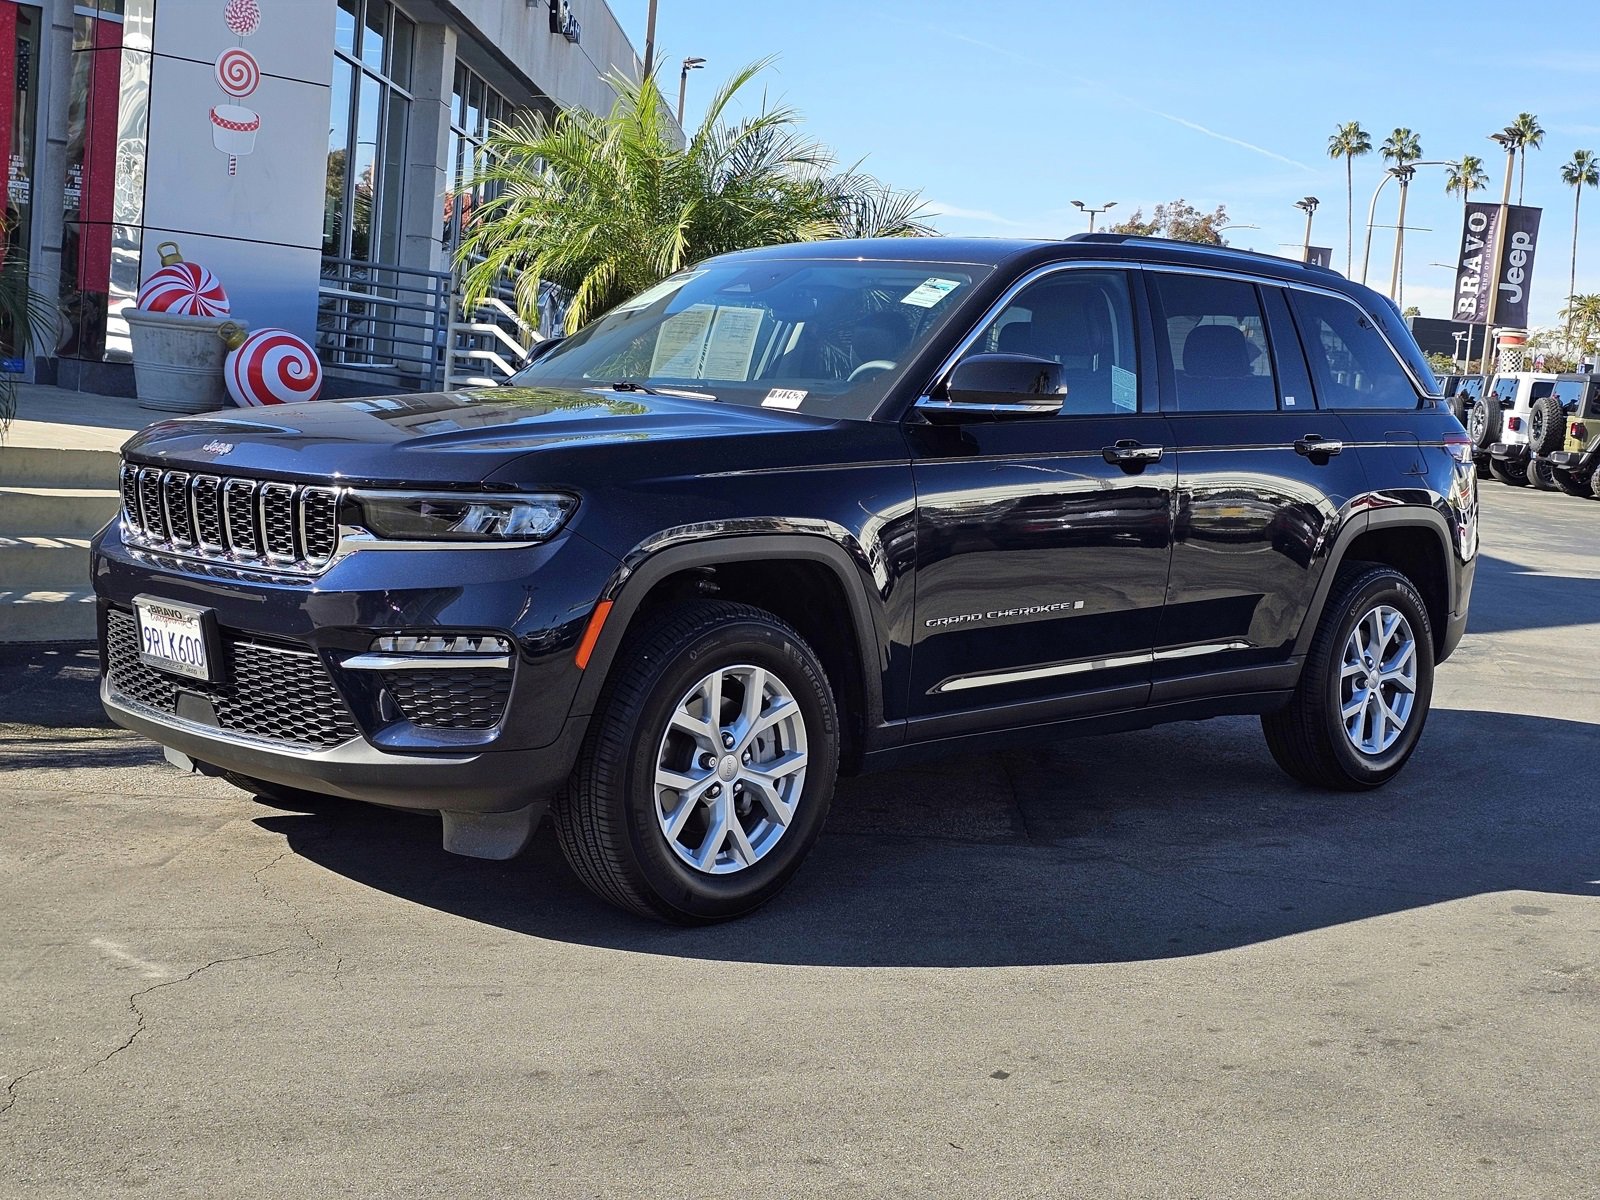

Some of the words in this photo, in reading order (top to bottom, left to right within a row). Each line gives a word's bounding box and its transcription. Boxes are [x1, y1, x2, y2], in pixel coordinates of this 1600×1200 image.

[1458, 212, 1487, 315] BRAVO
[1484, 261, 1490, 270] OF
[1499, 231, 1533, 304] Jeep
[202, 439, 234, 456] Jeep
[150, 604, 183, 619] BRAVO
[925, 613, 983, 627] GRAND
[986, 602, 1071, 619] CHEROKEE
[144, 626, 204, 667] 9RLK600
[802, 664, 834, 732] MICHELIN
